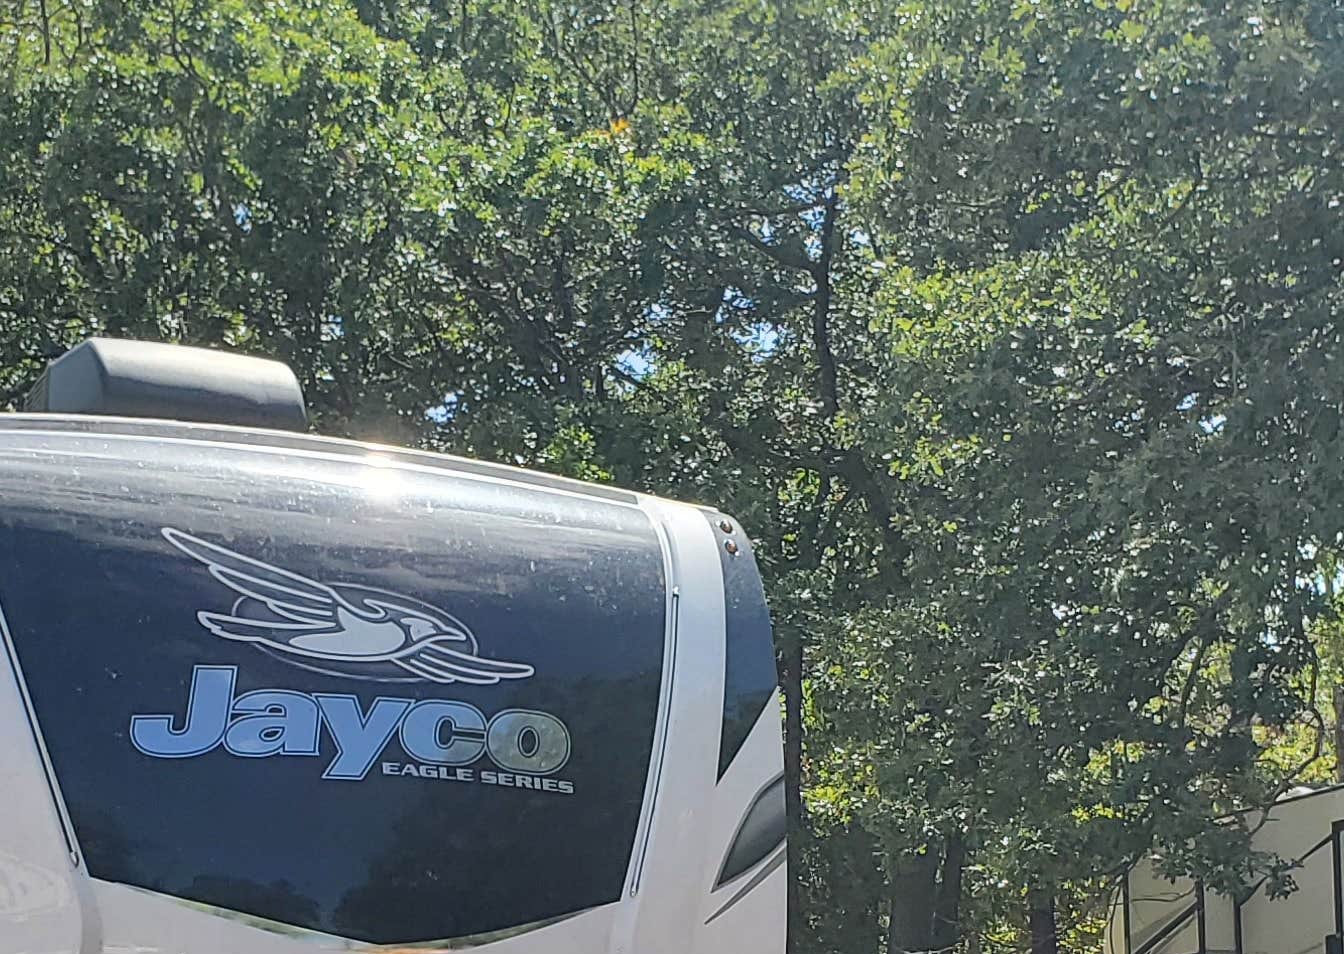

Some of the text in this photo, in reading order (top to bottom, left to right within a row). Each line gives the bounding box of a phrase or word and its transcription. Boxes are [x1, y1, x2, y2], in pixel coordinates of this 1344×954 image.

[130, 665, 571, 781] Jayco
[381, 761, 574, 794] EAGLE SERIES
